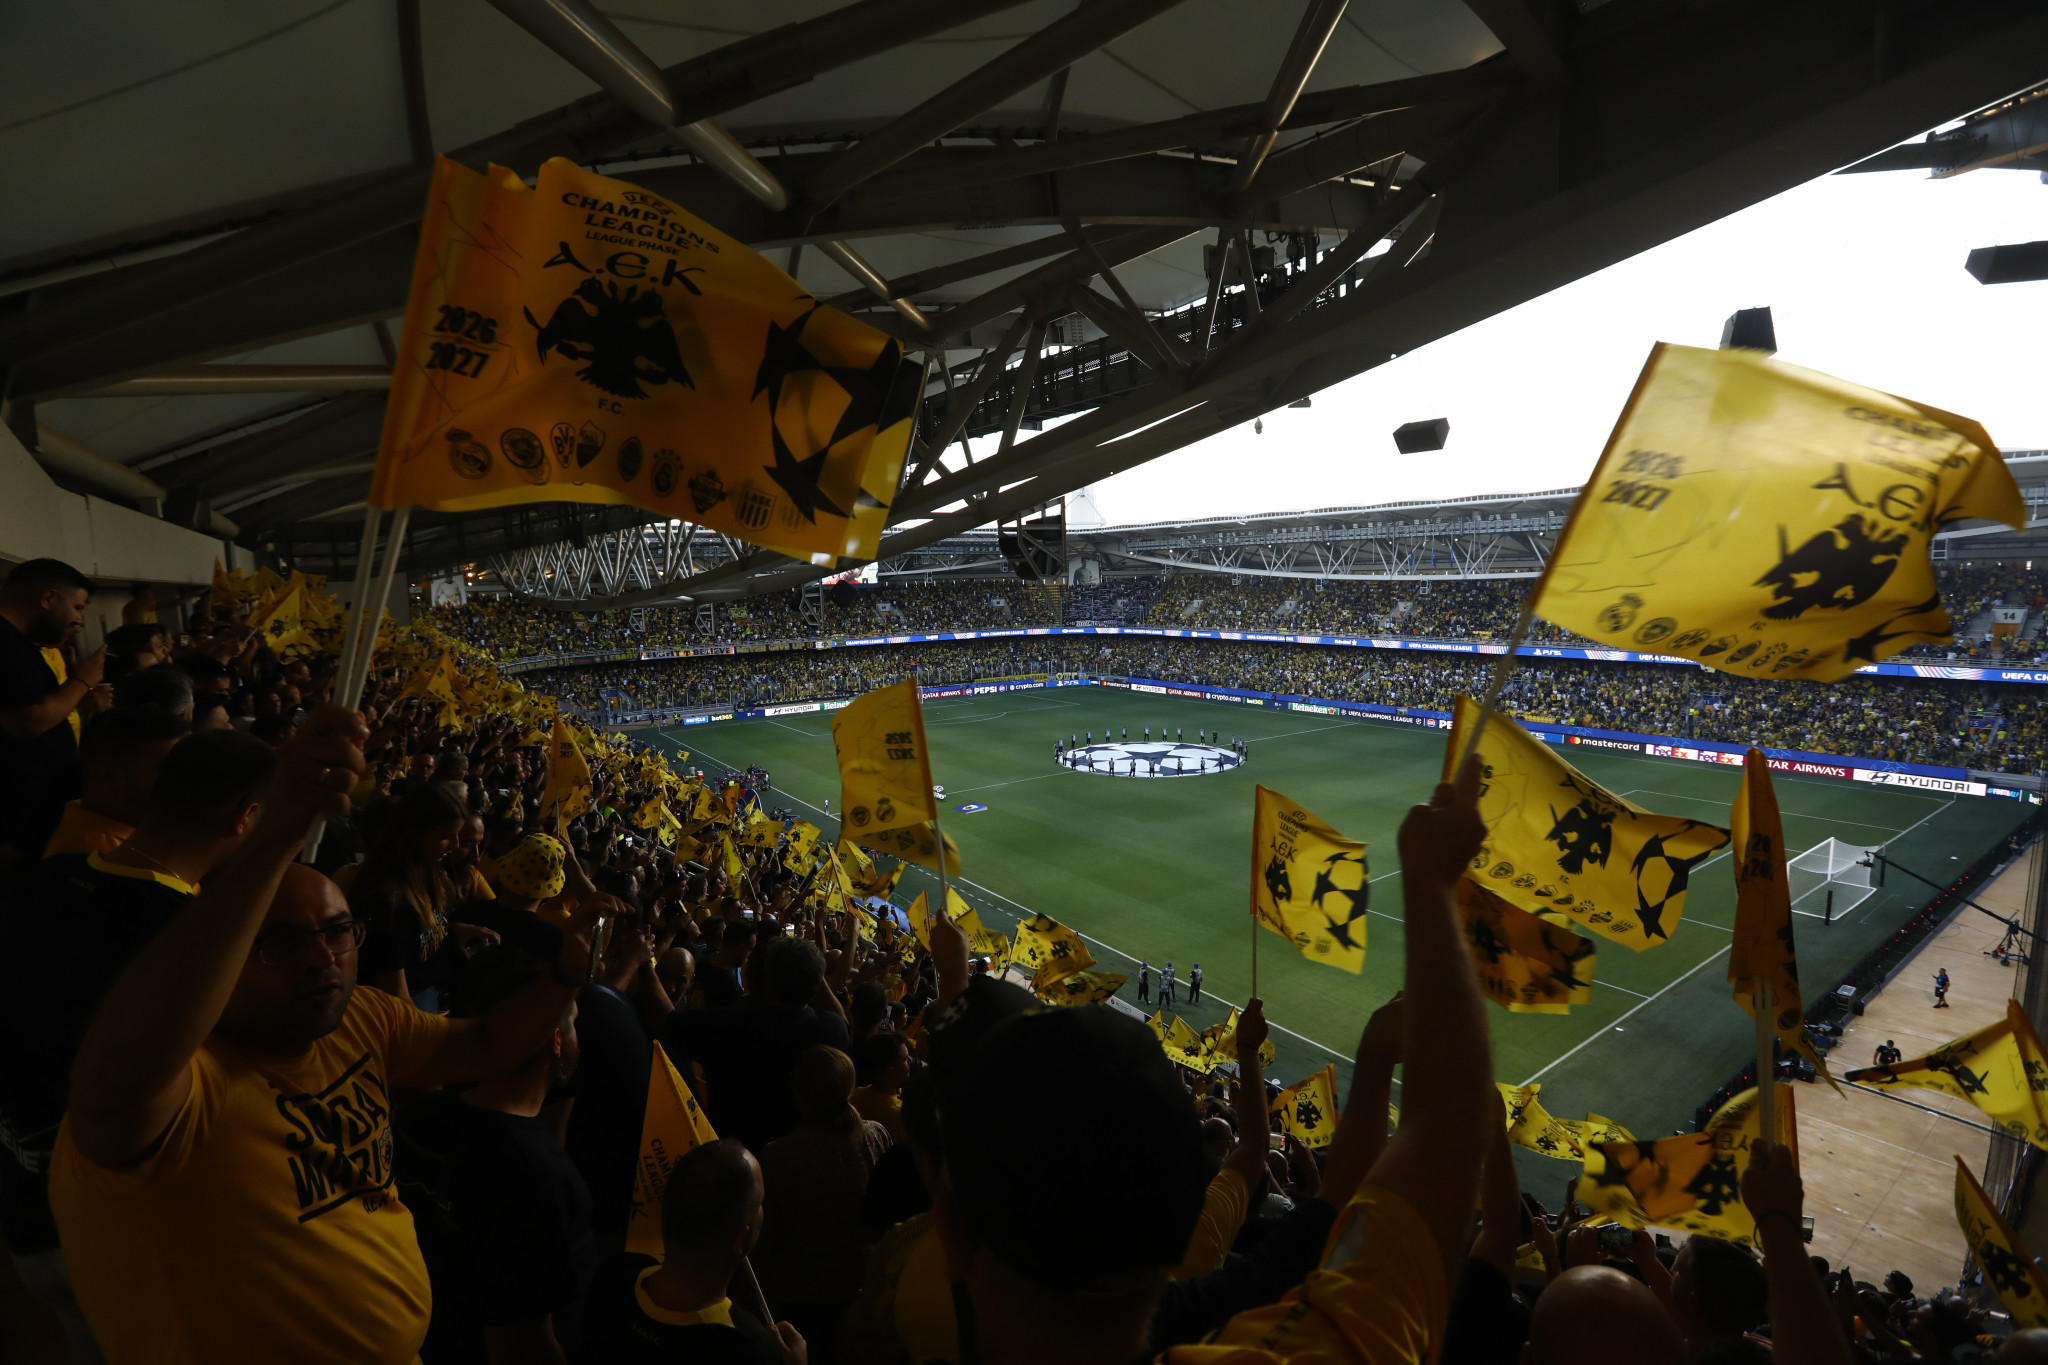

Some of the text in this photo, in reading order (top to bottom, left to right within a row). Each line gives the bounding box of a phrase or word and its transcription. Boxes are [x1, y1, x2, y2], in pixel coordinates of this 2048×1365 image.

[562, 192, 719, 254] CHAMPIONS
[585, 213, 690, 250] LEAGUE
[585, 230, 679, 256] LEAGUE PHASE
[434, 304, 498, 344] 2026
[425, 341, 490, 379] 2027
[2003, 612, 2016, 621] 14
[1639, 654, 1660, 662] UEFA
[2002, 672, 2048, 682] UEFA CH
[974, 686, 998, 695] PEPSI
[1016, 682, 1044, 690] crypto.com
[922, 689, 961, 700] QATAR AIRWAYS
[1211, 693, 1242, 703] crypto.com
[1246, 698, 1264, 706] bet365
[785, 705, 814, 714] HYUNDAI
[1292, 702, 1328, 715] Heineken
[712, 714, 733, 722] bet365
[1362, 712, 1392, 721] CHAMPIONS
[1393, 716, 1413, 724] LEAGUE
[1582, 738, 1640, 751] mastercard
[1653, 745, 1688, 759] FedEx
[1698, 750, 1735, 765] FedEx
[1766, 760, 1846, 777] TAR AIRWAYS
[1897, 774, 1970, 793] HYUNDAI
